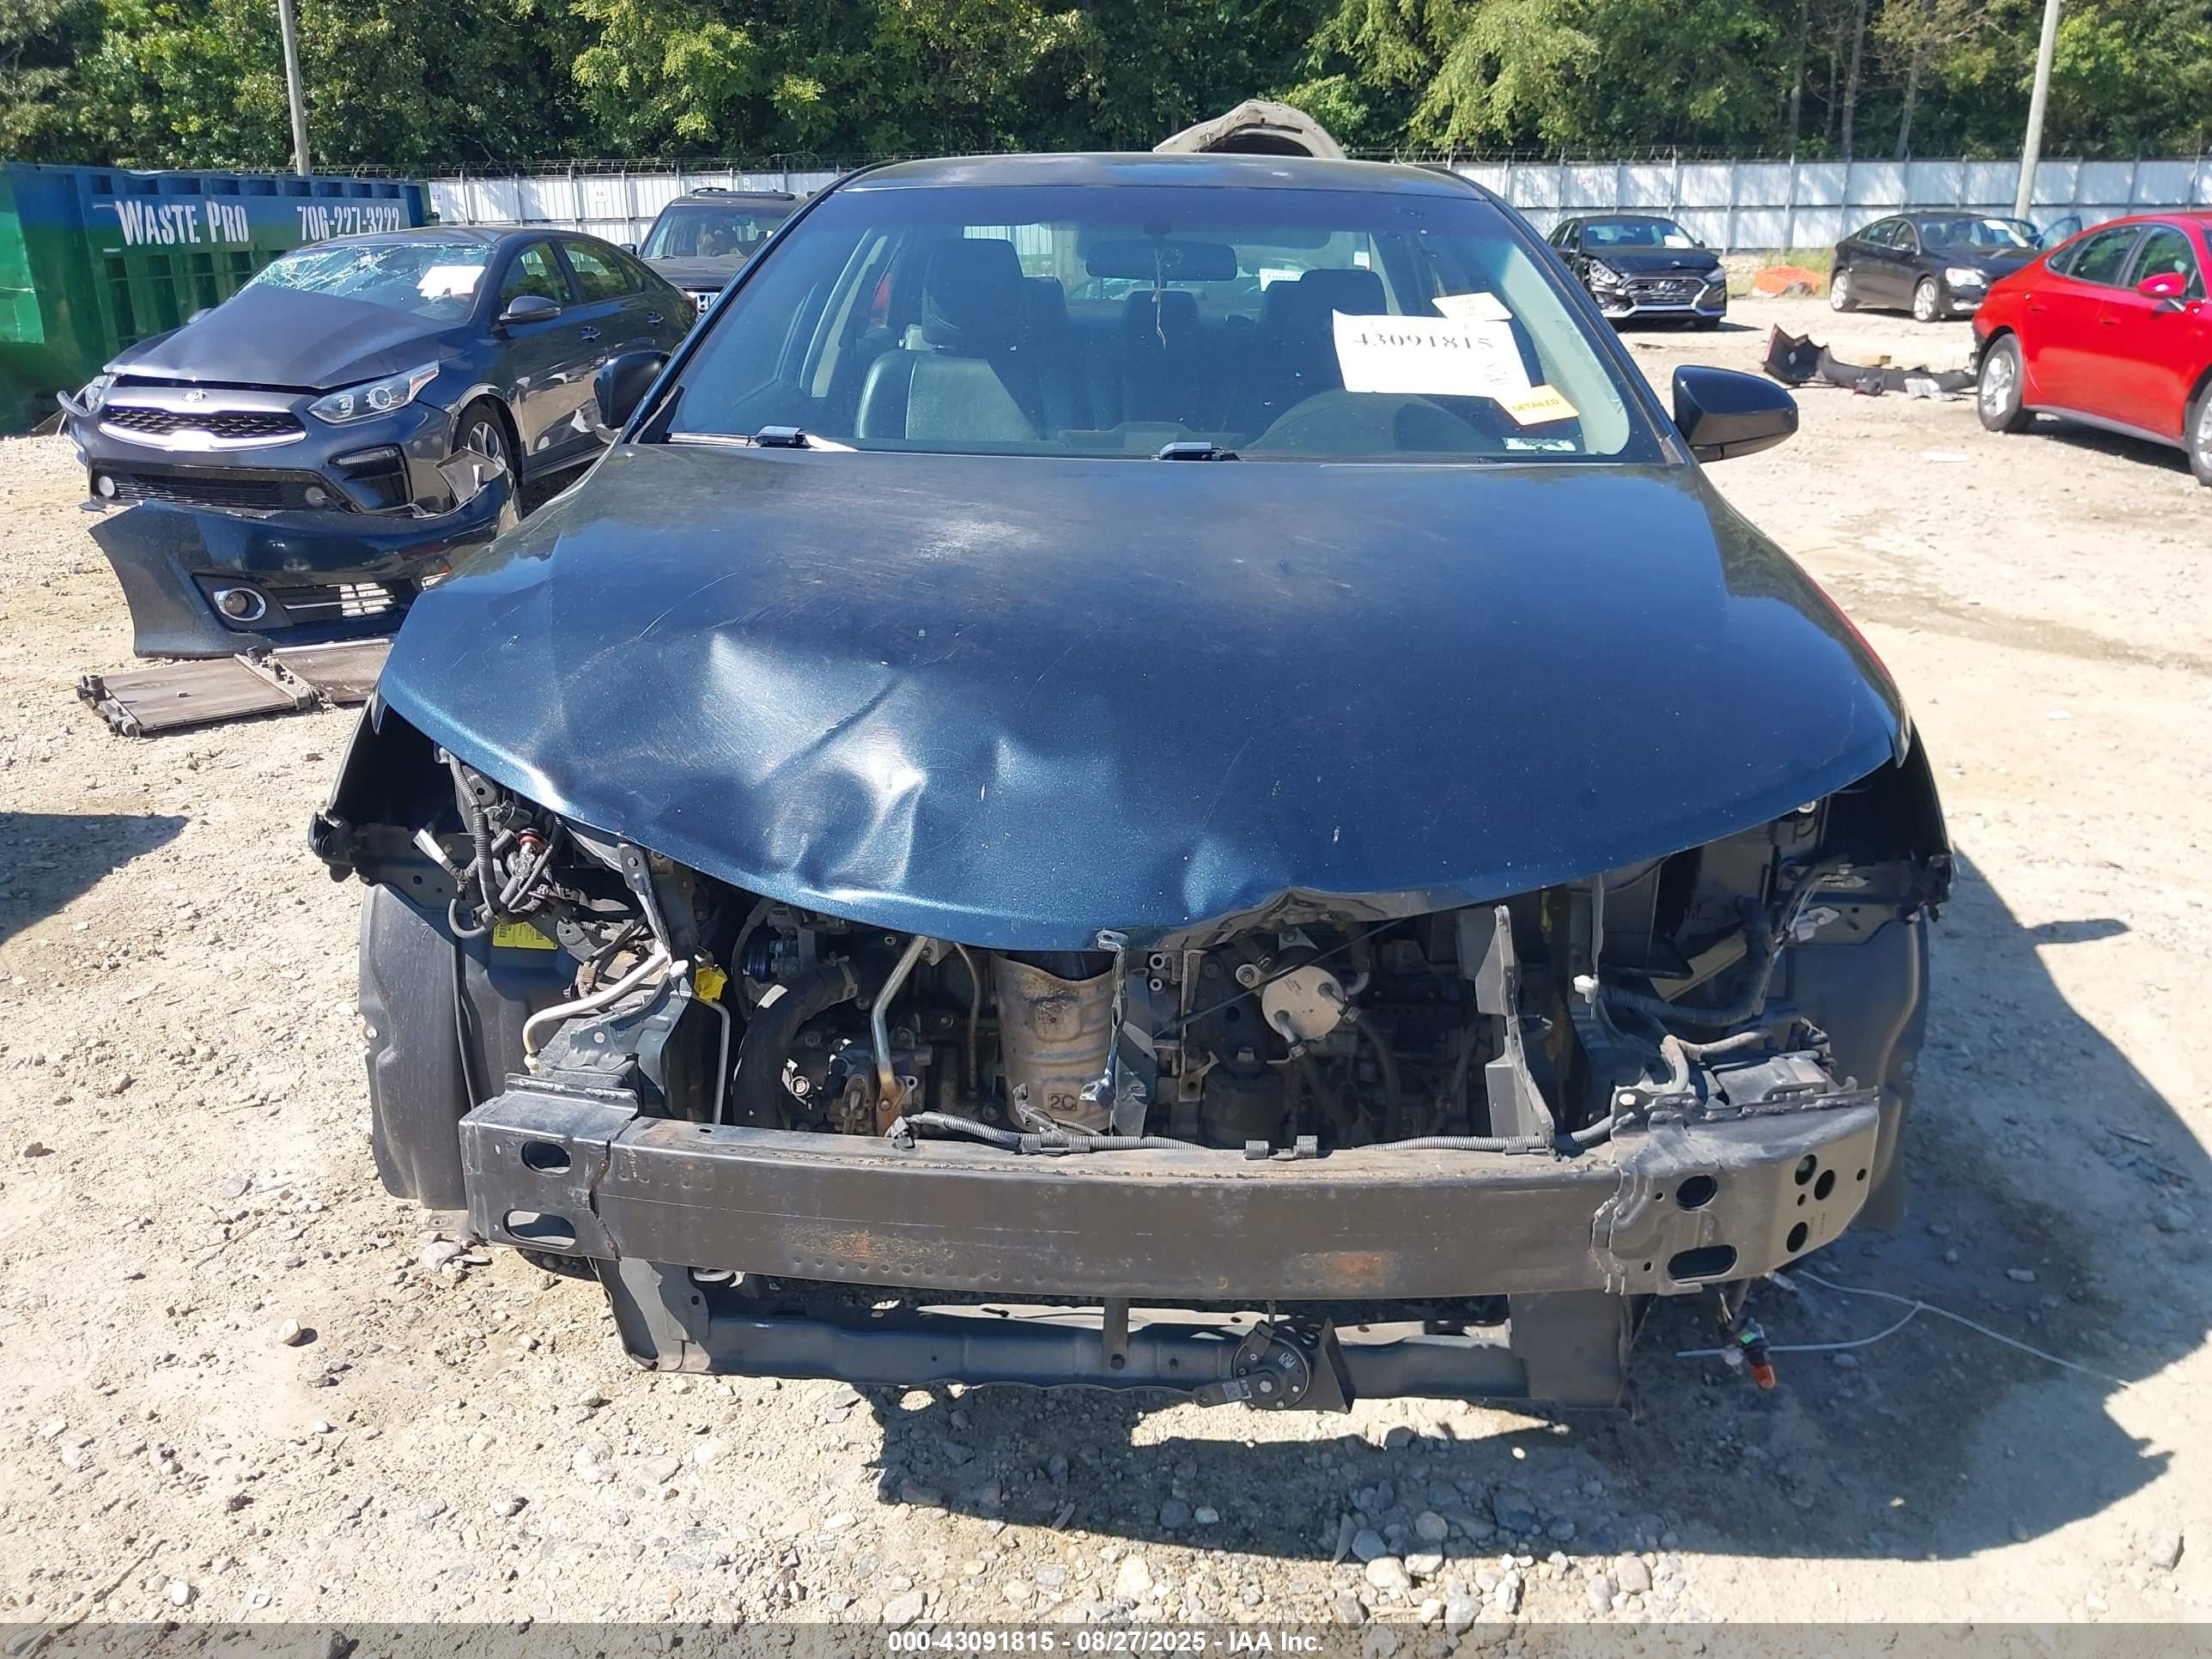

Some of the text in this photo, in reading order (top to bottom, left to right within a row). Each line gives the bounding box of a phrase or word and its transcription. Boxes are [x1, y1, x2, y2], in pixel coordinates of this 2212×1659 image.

[115, 200, 249, 246] WASTE PRO
[1354, 332, 1493, 349] 43091815
[1511, 398, 1559, 412] DETAILED
[1050, 1095, 1075, 1109] 2C
